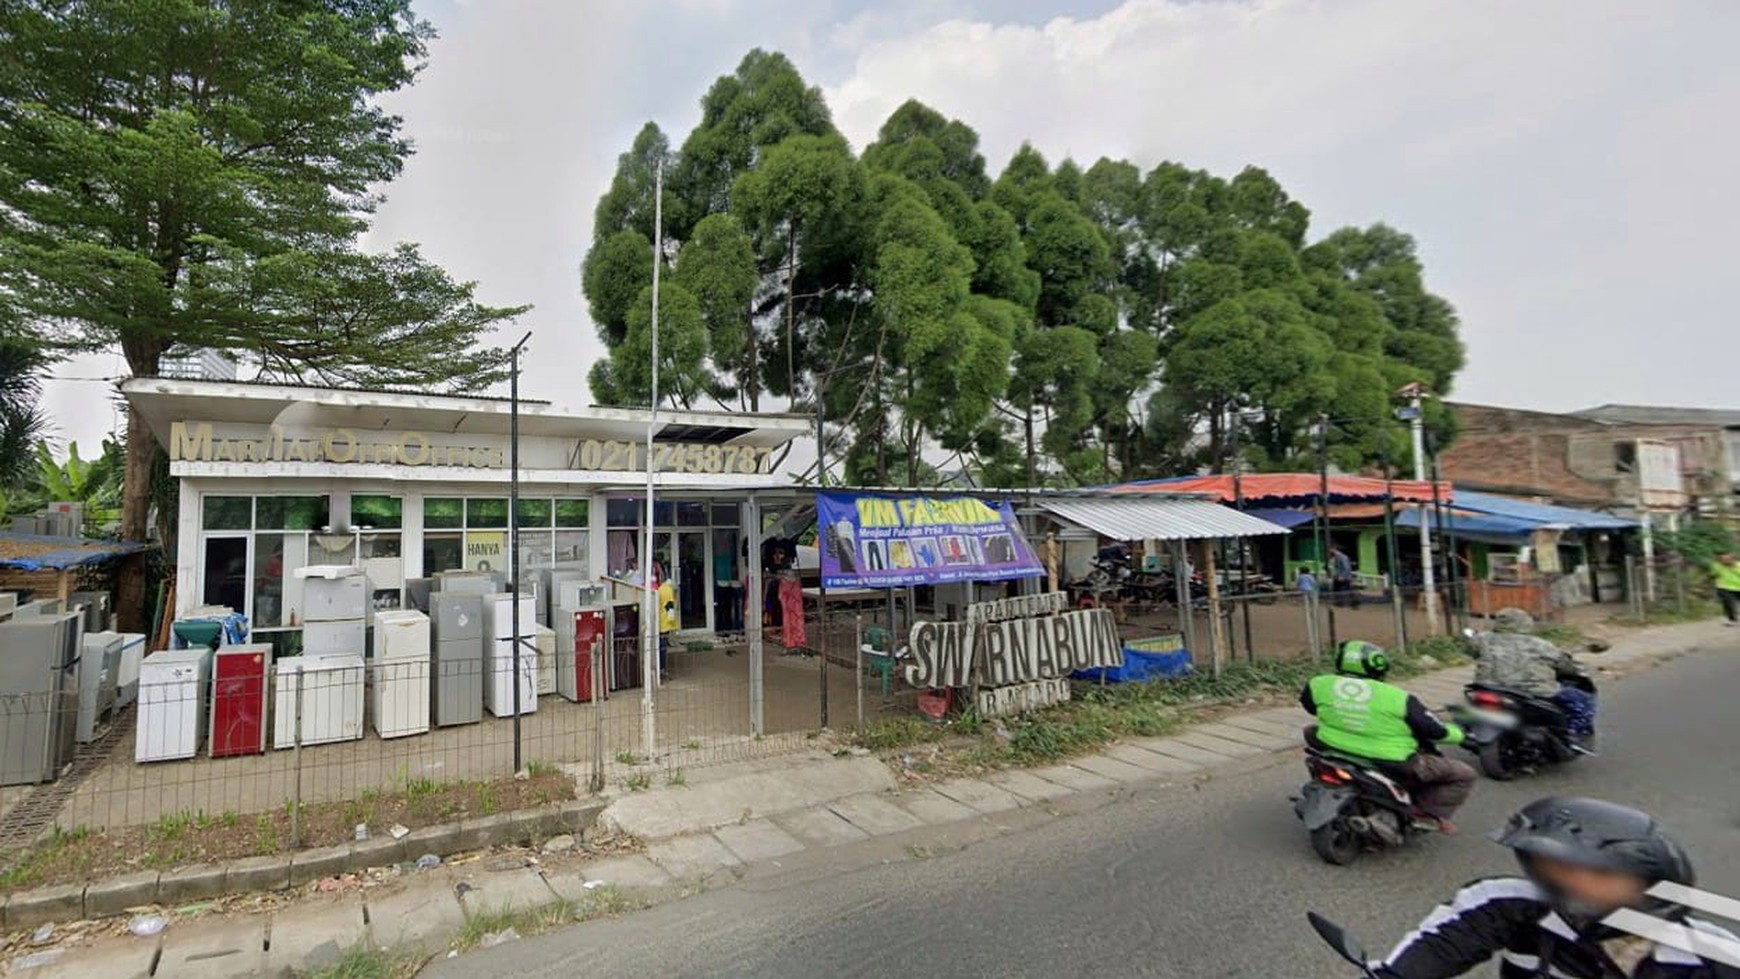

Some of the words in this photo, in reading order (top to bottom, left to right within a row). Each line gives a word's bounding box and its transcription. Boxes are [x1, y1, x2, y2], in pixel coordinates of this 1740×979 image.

[581, 439, 637, 471] 021
[652, 443, 772, 474] 7458787
[467, 543, 500, 556] HANYA
